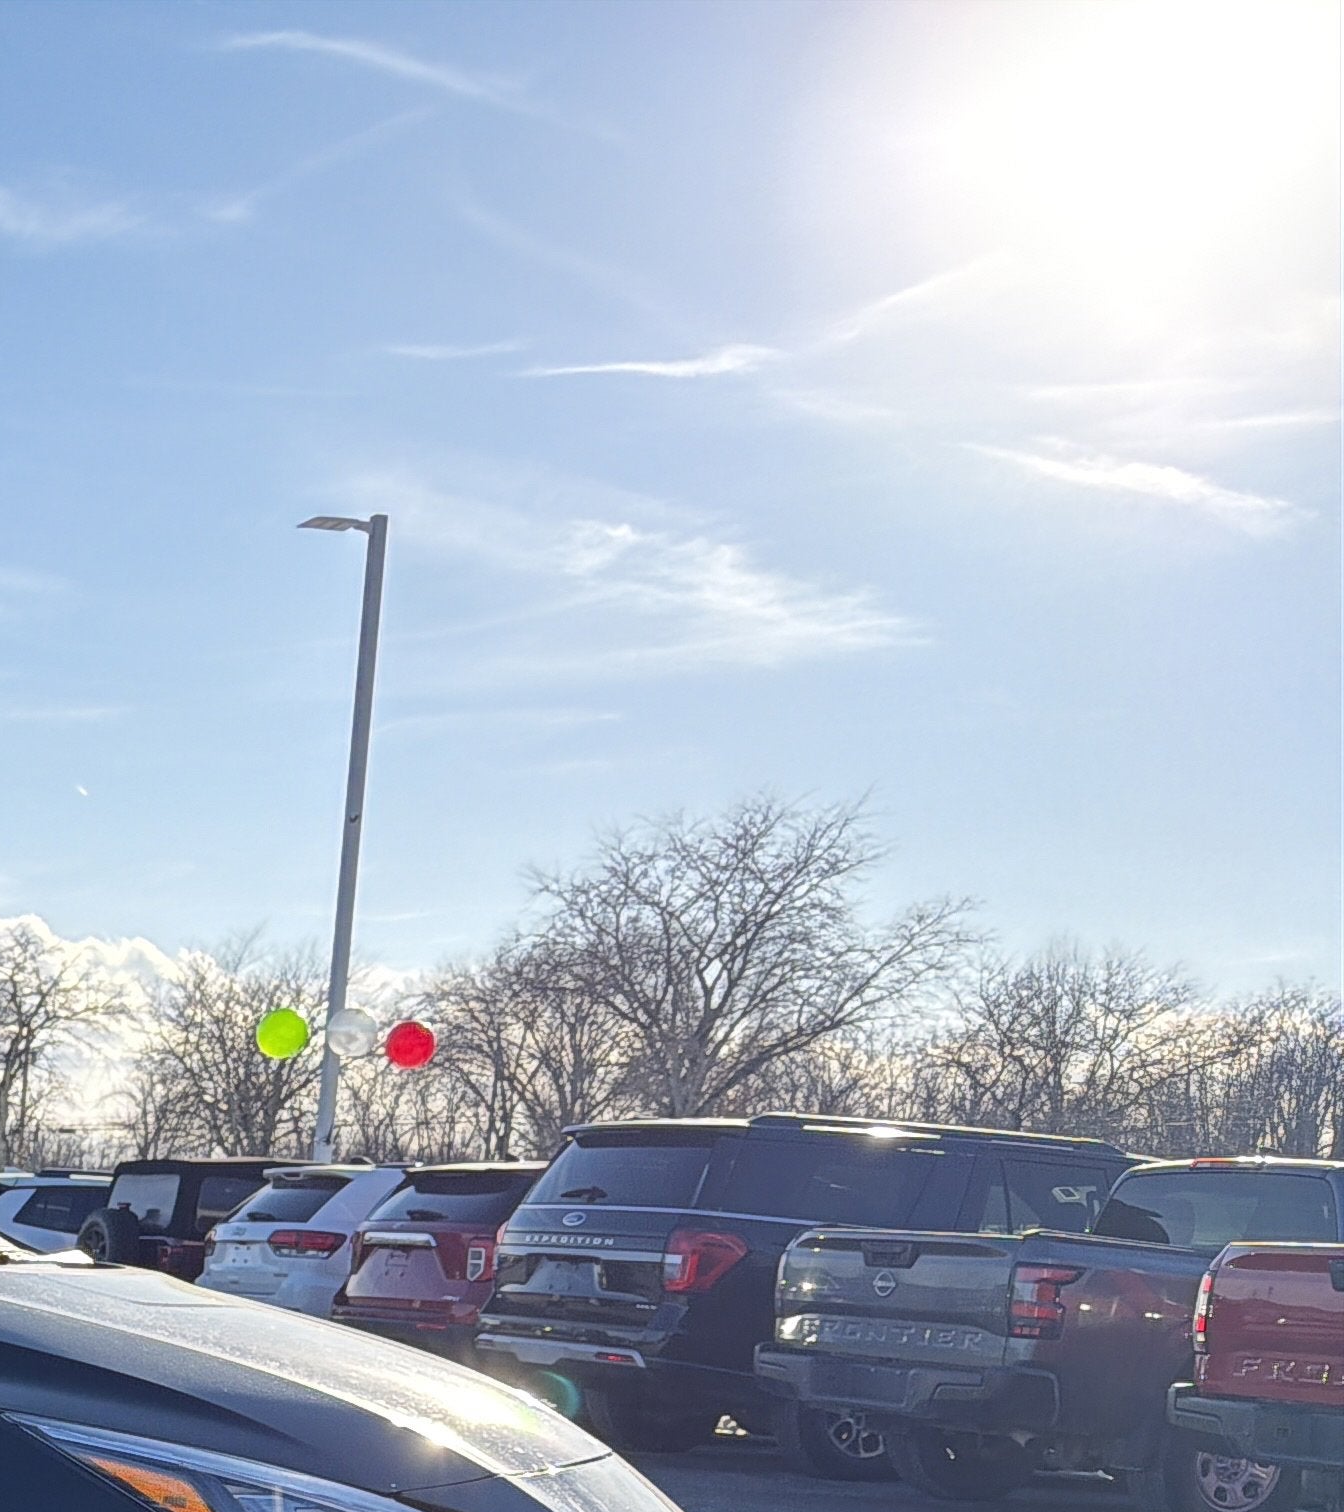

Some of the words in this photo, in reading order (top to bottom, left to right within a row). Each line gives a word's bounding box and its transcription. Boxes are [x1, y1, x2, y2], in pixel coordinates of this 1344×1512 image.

[525, 1235, 615, 1246] EXPEDITION
[801, 1319, 983, 1350] FRONTIER
[1232, 1358, 1344, 1386] FRO
